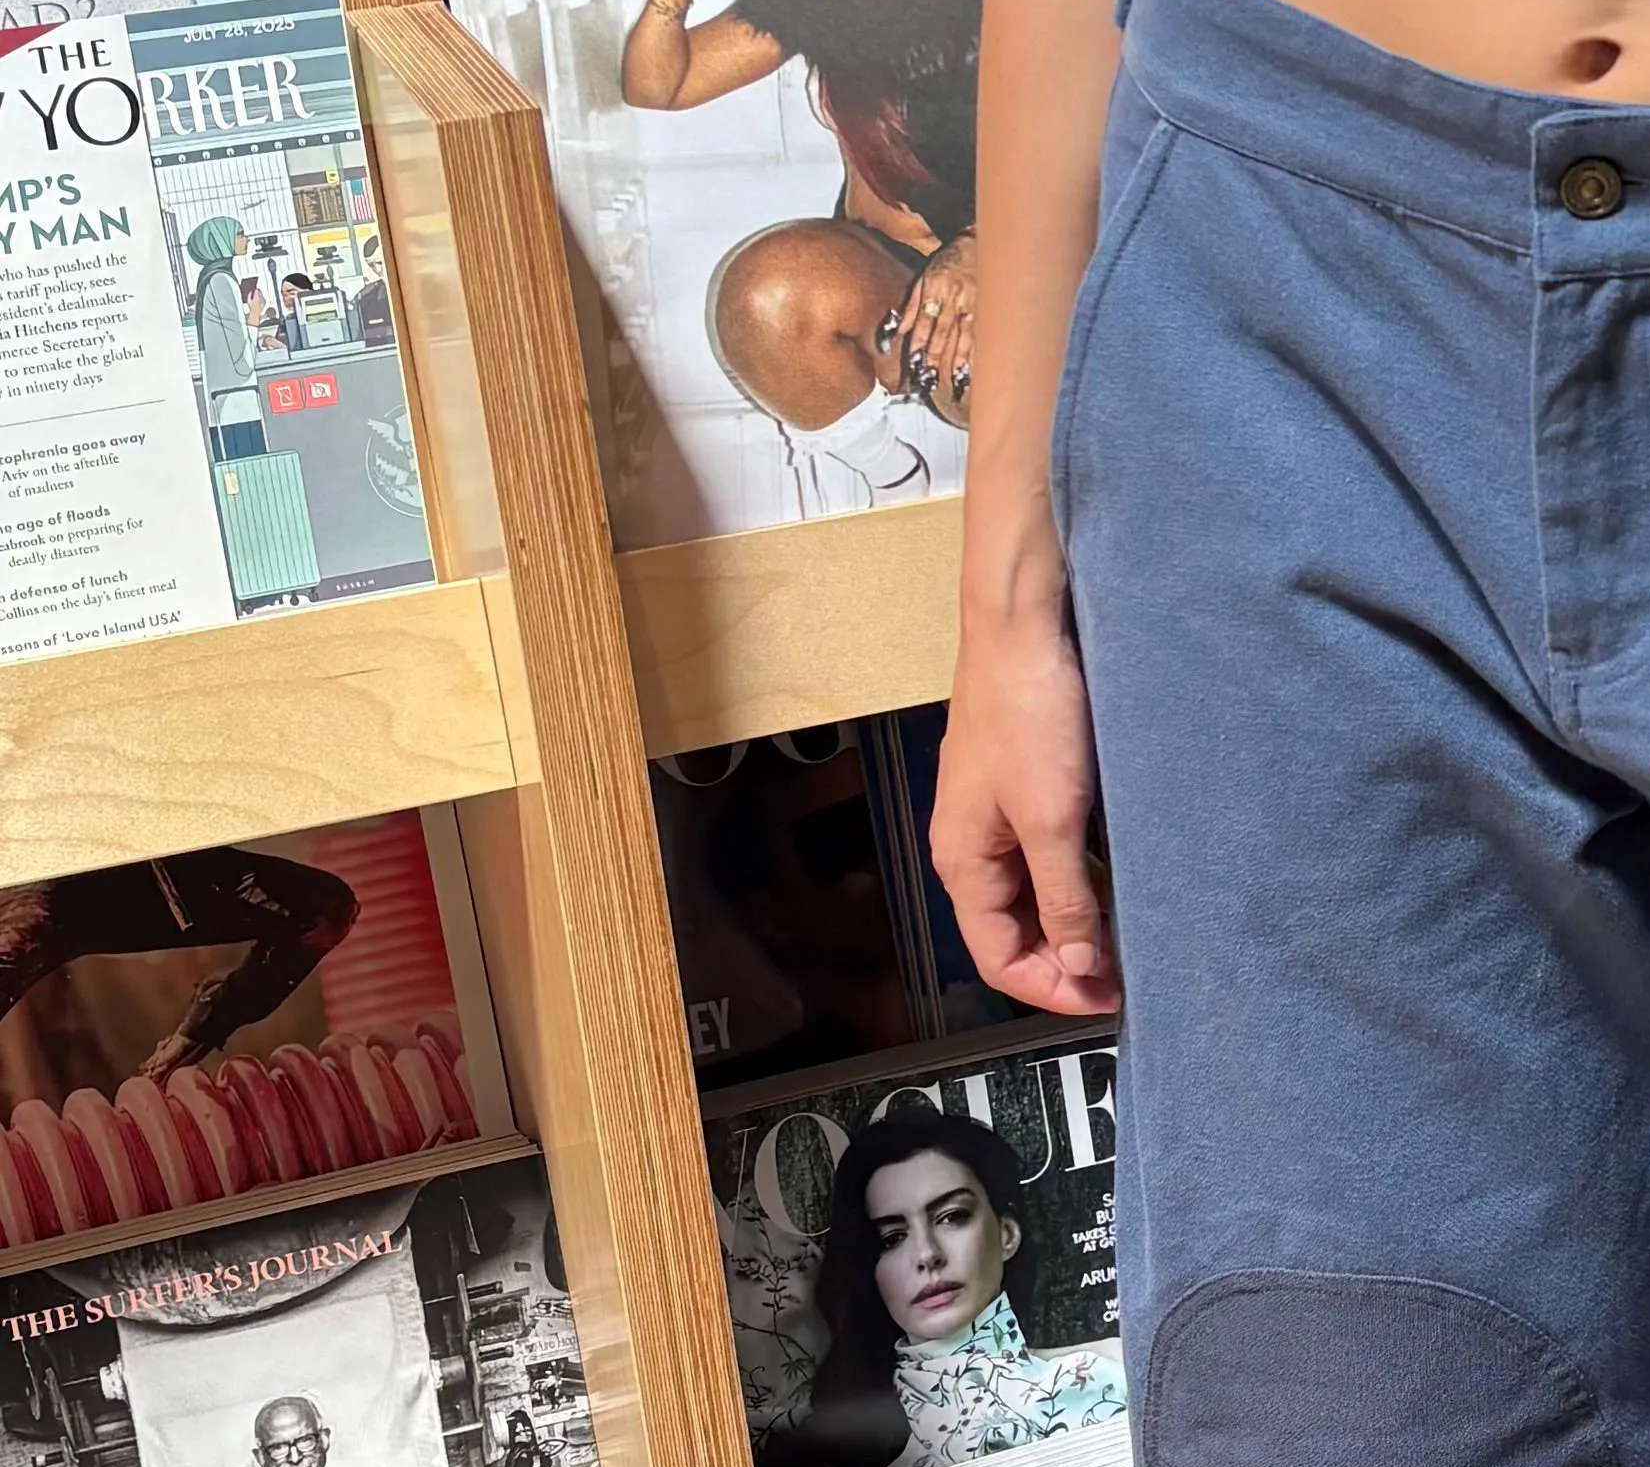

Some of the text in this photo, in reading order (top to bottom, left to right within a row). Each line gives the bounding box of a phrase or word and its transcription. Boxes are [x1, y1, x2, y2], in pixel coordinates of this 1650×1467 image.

[183, 16, 296, 45] JULY 28, 2025
[28, 38, 113, 76] THE
[34, 206, 132, 251] MAN
[28, 252, 128, 279] has pushed the
[7, 276, 117, 301] tariff policy, sees
[57, 292, 136, 313] dealmaker-
[15, 312, 129, 339] Hitchens reports
[42, 332, 116, 354] Secretary's
[4, 345, 145, 379] to remake the global
[8, 373, 104, 399] in ninety days
[72, 432, 147, 456] goes away
[32, 465, 49, 478] on
[51, 462, 71, 474] the
[73, 453, 120, 471] afterlife
[8, 479, 75, 499] of madness
[16, 505, 112, 533] age of floods
[49, 517, 145, 544] on preparing for
[8, 543, 101, 569] deadly disasters
[10, 570, 129, 602] defense of lunch
[42, 602, 58, 614] on
[61, 596, 80, 610] the
[83, 590, 112, 607] day's
[113, 586, 147, 601] finest
[148, 579, 178, 594] meal
[43, 633, 58, 648] of
[103, 618, 146, 636] Island
[1071, 1226, 1108, 1245] TAKES
[1, 1229, 404, 1344] THE SURFER'S JOURNAL
